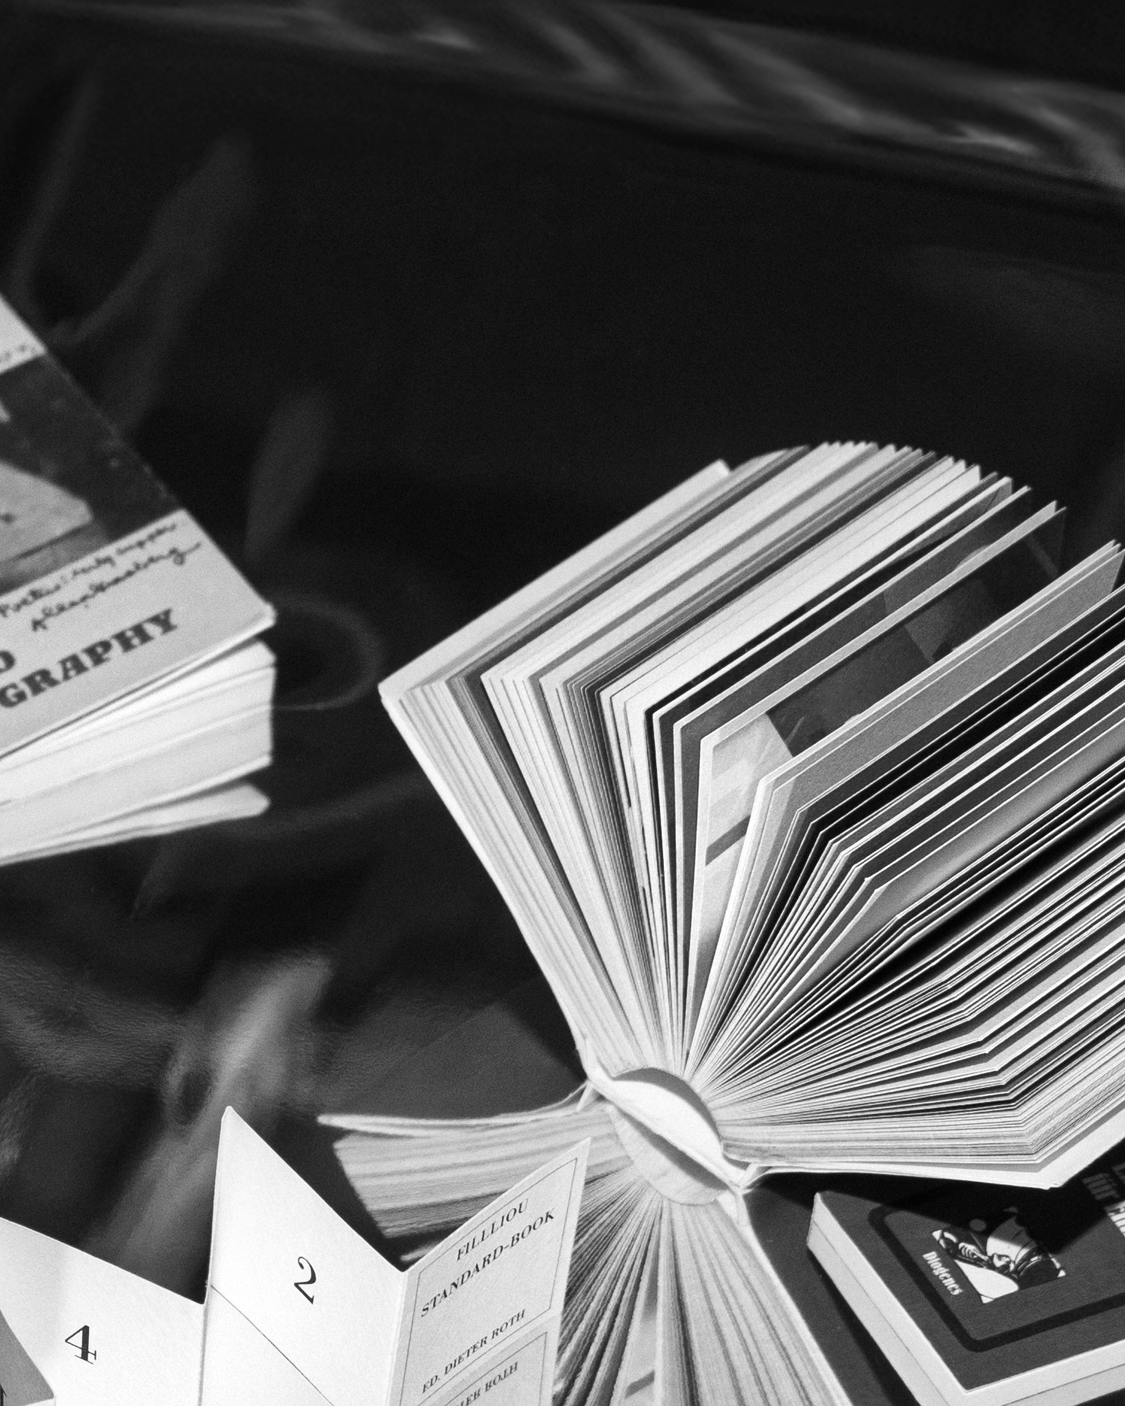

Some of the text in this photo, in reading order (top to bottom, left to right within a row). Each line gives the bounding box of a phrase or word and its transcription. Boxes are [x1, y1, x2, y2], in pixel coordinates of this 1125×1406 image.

[293, 1256, 317, 1305] 2
[421, 1207, 556, 1318] STANDARD-BOOK
[922, 1250, 964, 1295] Diogenes
[64, 1324, 97, 1365] 4
[422, 1309, 525, 1394] ED. DIETER ROTH
